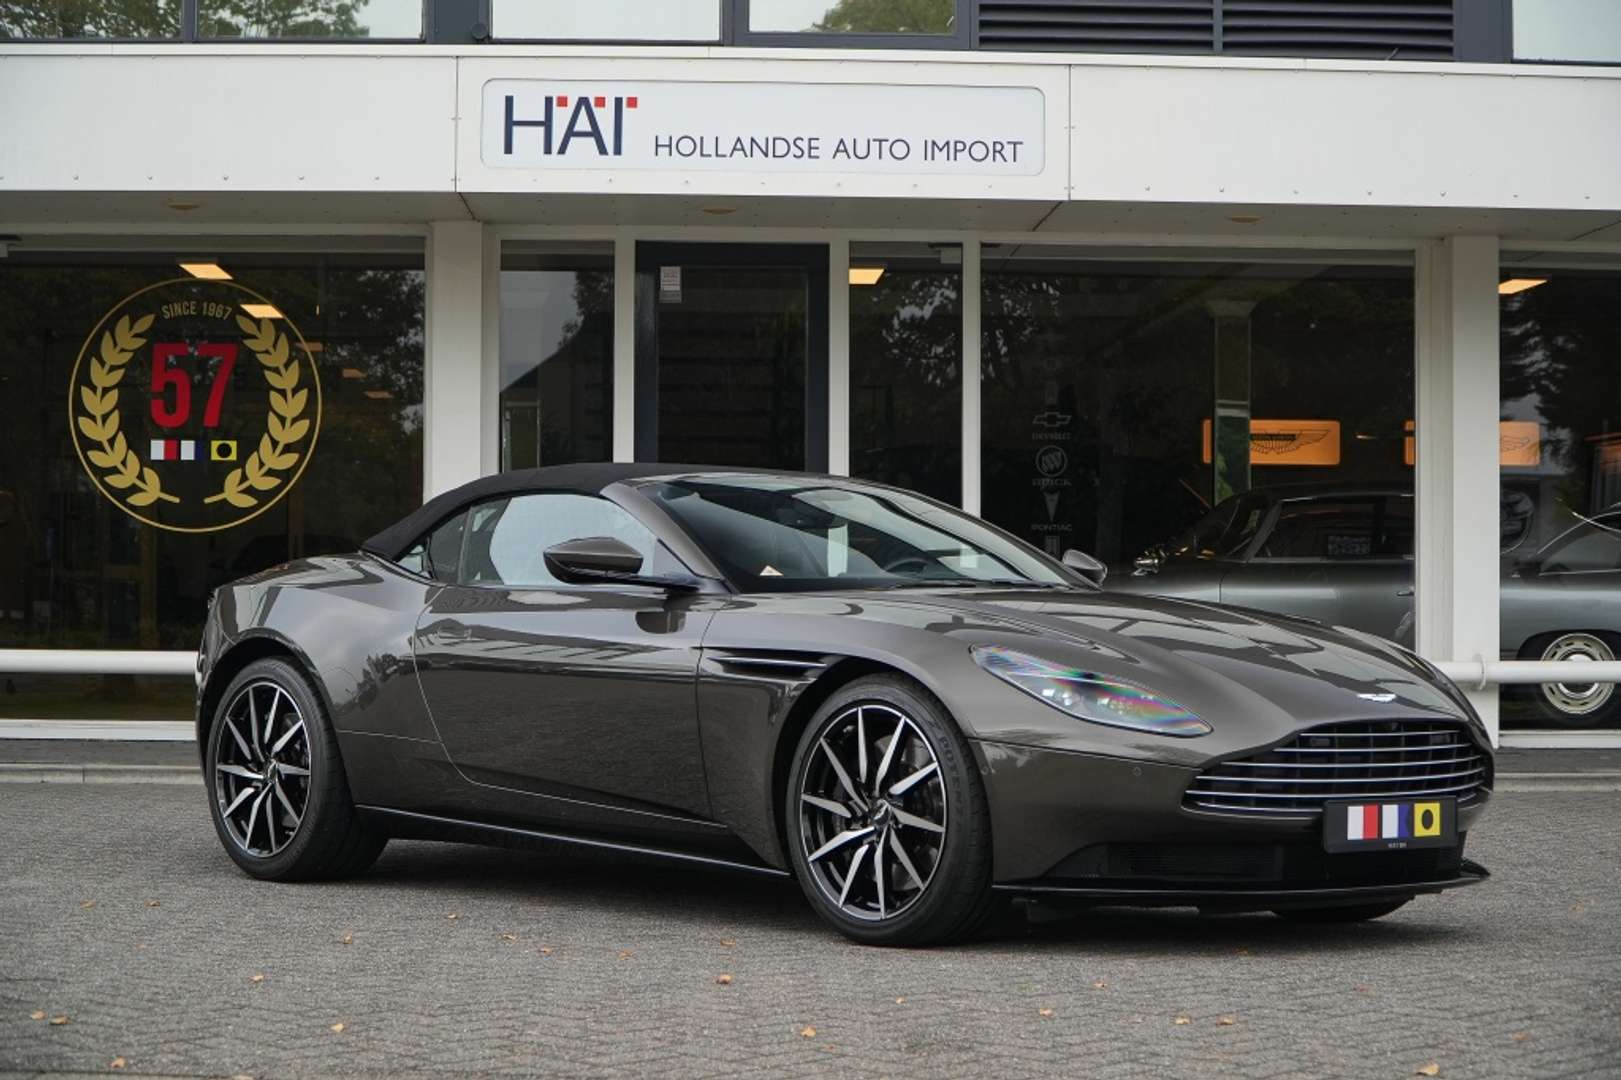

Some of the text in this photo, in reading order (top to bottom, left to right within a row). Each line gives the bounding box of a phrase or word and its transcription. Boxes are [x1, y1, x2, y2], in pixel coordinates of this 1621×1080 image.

[655, 135, 1024, 163] HOLLANDSE AUTO IMPORT
[161, 301, 197, 319] SINCE
[150, 342, 238, 428] 57
